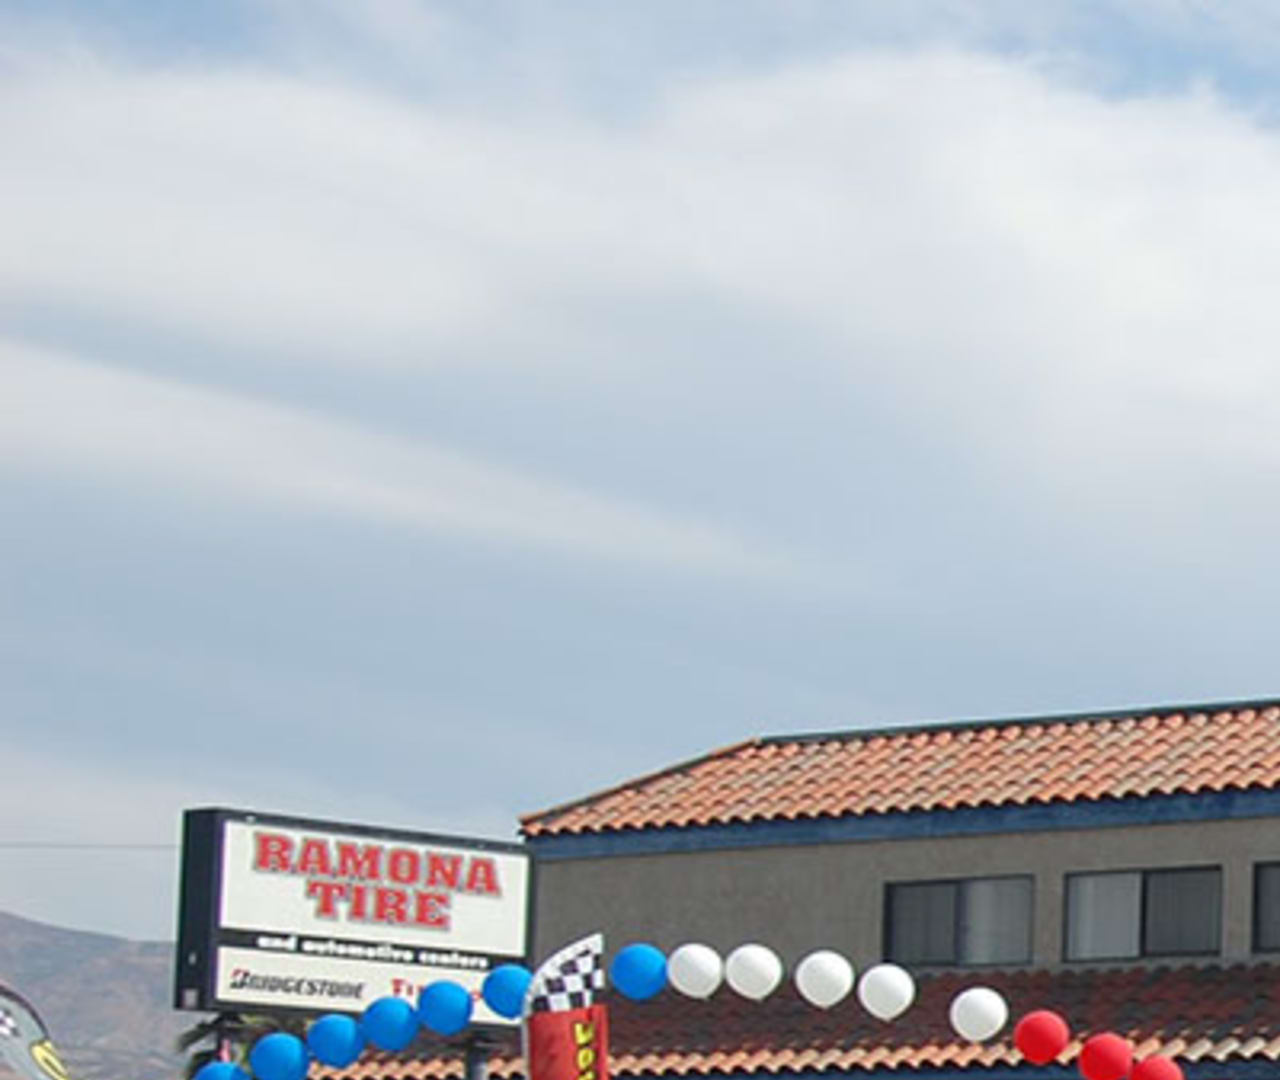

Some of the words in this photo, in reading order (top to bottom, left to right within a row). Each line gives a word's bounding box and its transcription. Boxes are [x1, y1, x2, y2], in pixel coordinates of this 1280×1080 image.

[252, 832, 501, 896] RAMONA
[306, 880, 451, 930] TIRE
[257, 935, 296, 950] and
[302, 939, 414, 963] automotive
[229, 968, 366, 998] BRIDGESTONE
